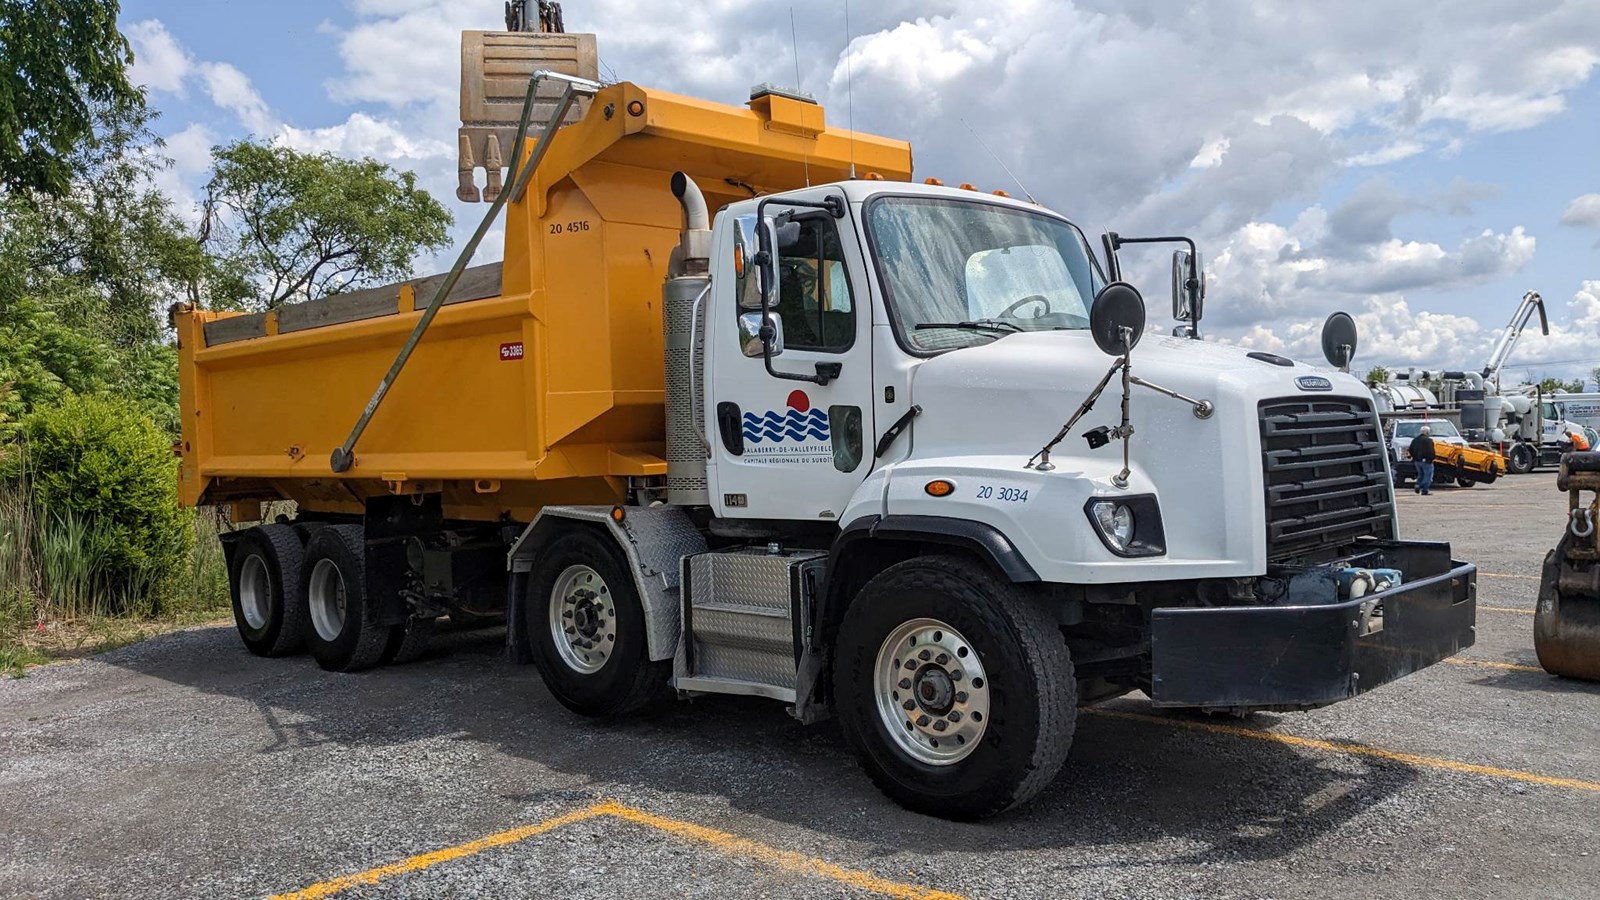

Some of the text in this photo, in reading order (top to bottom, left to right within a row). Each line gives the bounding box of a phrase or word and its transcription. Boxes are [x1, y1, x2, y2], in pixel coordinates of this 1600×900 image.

[550, 220, 589, 234] 20 4516
[976, 485, 1029, 503] 20 3034
